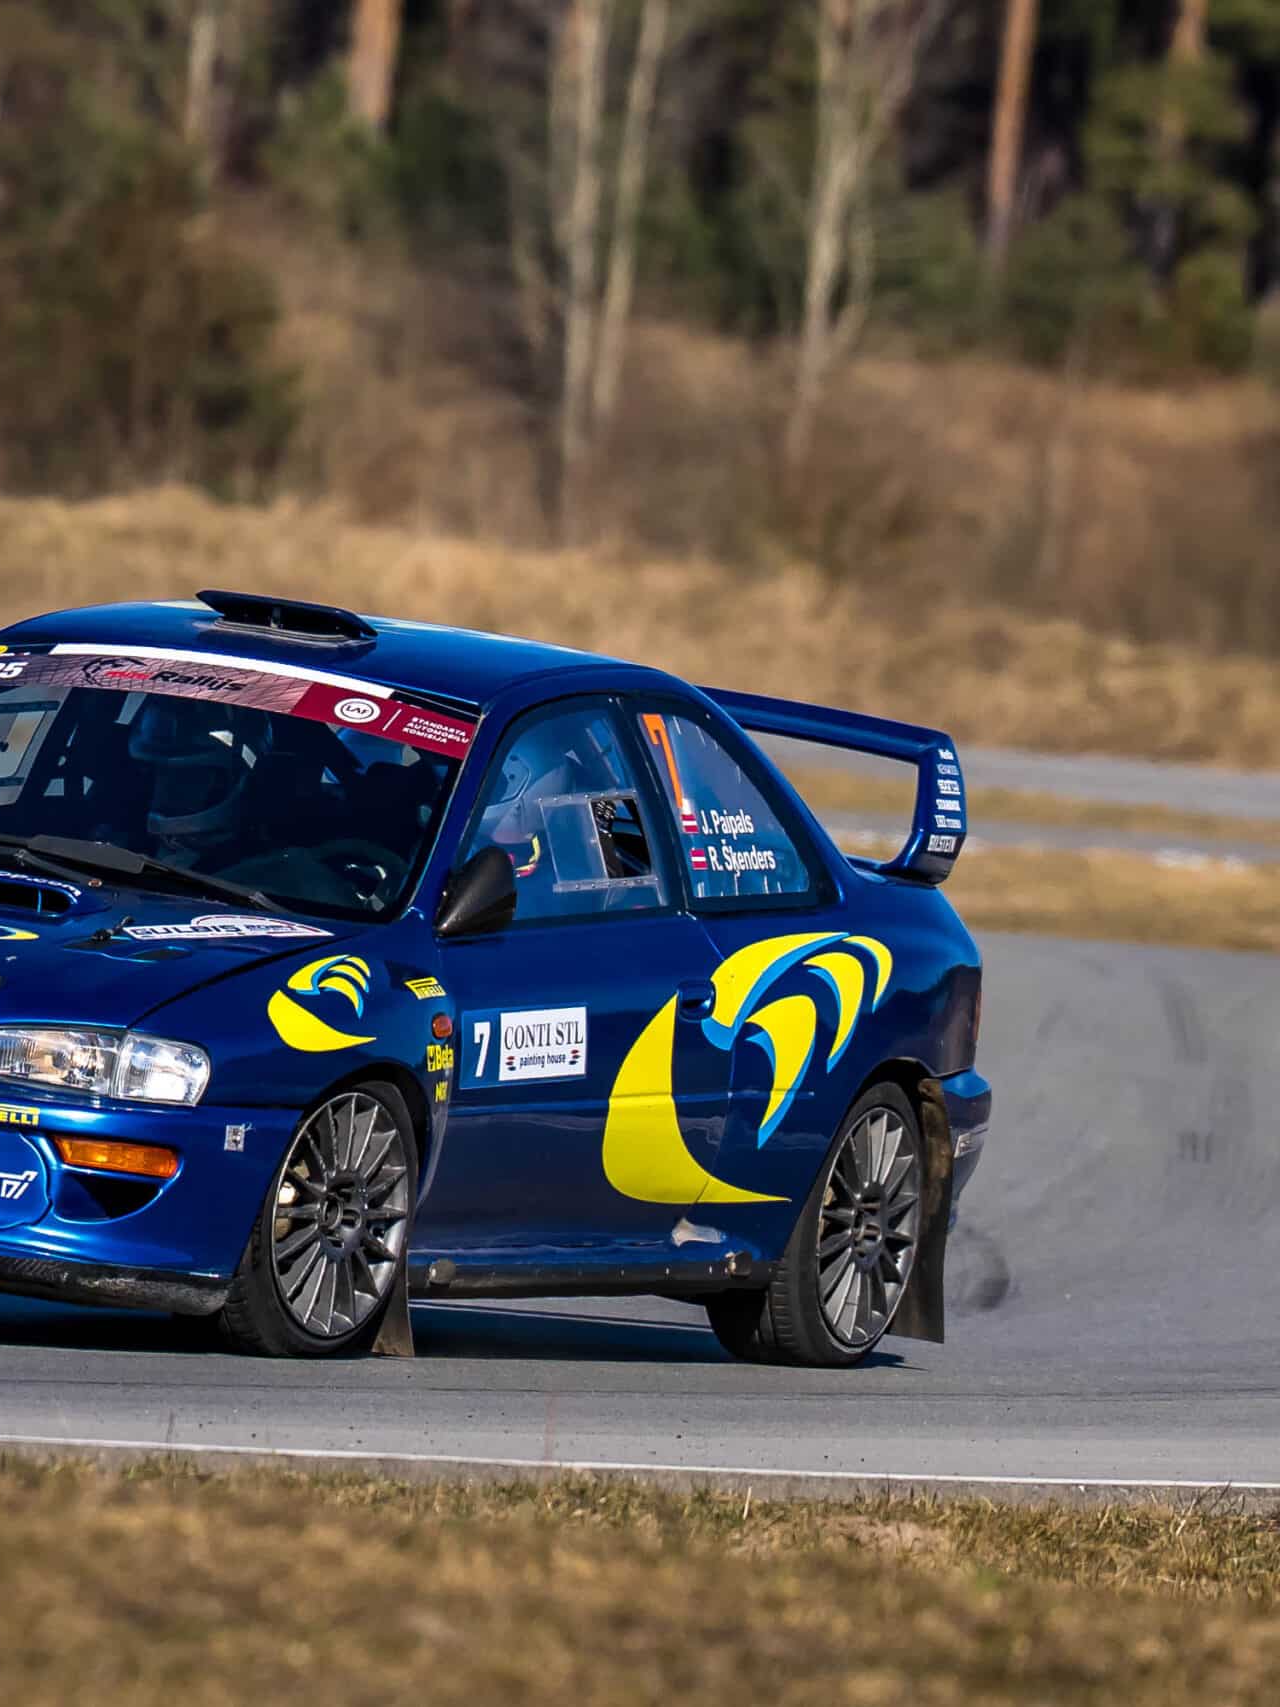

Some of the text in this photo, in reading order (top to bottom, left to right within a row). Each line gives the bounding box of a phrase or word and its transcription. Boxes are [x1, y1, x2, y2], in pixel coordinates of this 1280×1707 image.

[402, 727, 448, 744] KOMISIJA
[411, 716, 467, 737] STANDARTA
[641, 713, 684, 808] 7
[700, 808, 755, 840] J. Paipals
[707, 845, 724, 872] R.
[503, 1020, 584, 1050] CONTI STL
[473, 1021, 491, 1078] 7
[519, 1053, 567, 1069] painting house
